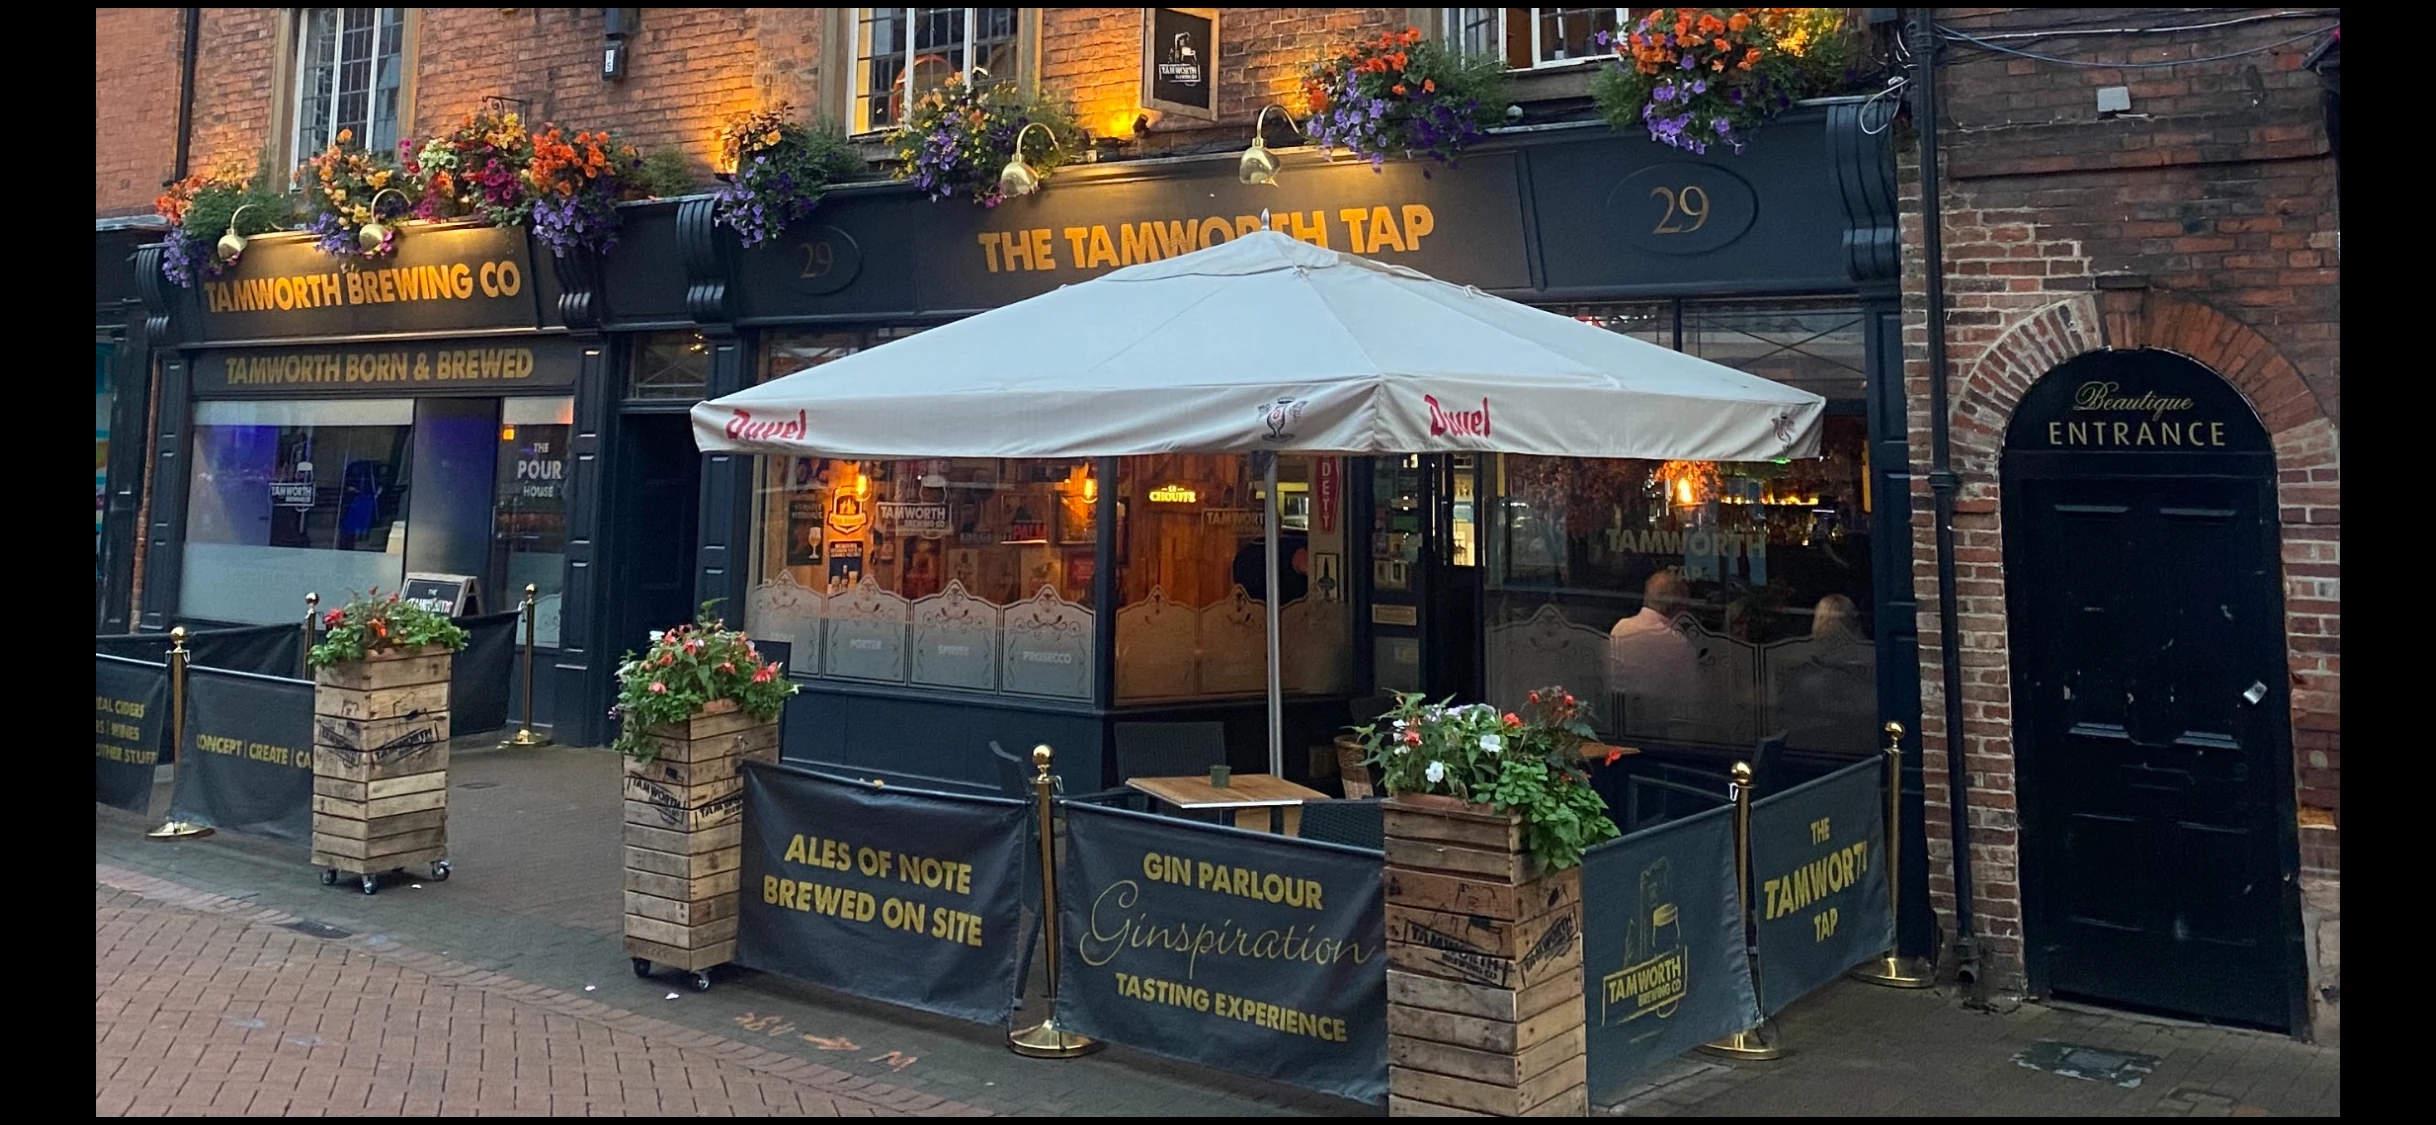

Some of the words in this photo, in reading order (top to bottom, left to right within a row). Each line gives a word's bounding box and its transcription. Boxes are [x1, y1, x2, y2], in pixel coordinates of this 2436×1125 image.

[1651, 186, 1709, 234] 29
[978, 229, 1056, 272] THE
[1340, 204, 1434, 254] TAP
[799, 241, 834, 279] 29
[204, 273, 342, 313] TAMWORTH
[349, 263, 473, 305] BREWING
[479, 260, 521, 298] CO
[226, 353, 340, 385] TAMWORTH
[345, 353, 406, 383] BORN
[413, 358, 429, 379] &
[436, 349, 534, 380] BREWED
[1424, 394, 1490, 438] Duvel
[2073, 381, 2194, 422] Beautique
[726, 409, 807, 440] Duvel
[2049, 422, 2226, 447] ENTRANCE
[533, 442, 549, 453] THE
[517, 460, 562, 480] POUR
[523, 485, 554, 498] HOUSE
[880, 506, 946, 520] TAMWORTH
[1206, 511, 1265, 525] TAMWORT
[1605, 528, 1767, 559] TAMWORTH
[1022, 650, 1072, 665] PROSECCO
[115, 699, 145, 719] CIDERS
[111, 722, 140, 741] WINES
[124, 748, 157, 765] STUFF
[250, 743, 288, 765] CREATE
[1810, 817, 1831, 845] THE
[784, 834, 851, 871] ALES
[858, 847, 892, 878] OF
[899, 854, 972, 895] NOTE
[1143, 852, 1192, 886] GIN
[1198, 862, 1324, 910] PARLOUR
[763, 875, 876, 922] BREWED
[882, 897, 925, 934] ON
[931, 907, 982, 947] SITE
[1814, 907, 1838, 942] TAP
[1080, 880, 1376, 980] Ginspiration
[1609, 955, 1681, 1004] TAMWORTH
[1638, 985, 1670, 1008] BREWING
[1671, 979, 1682, 993] CO
[1115, 973, 1210, 1012] TASTING
[1215, 993, 1348, 1042] EXPERIENCE
